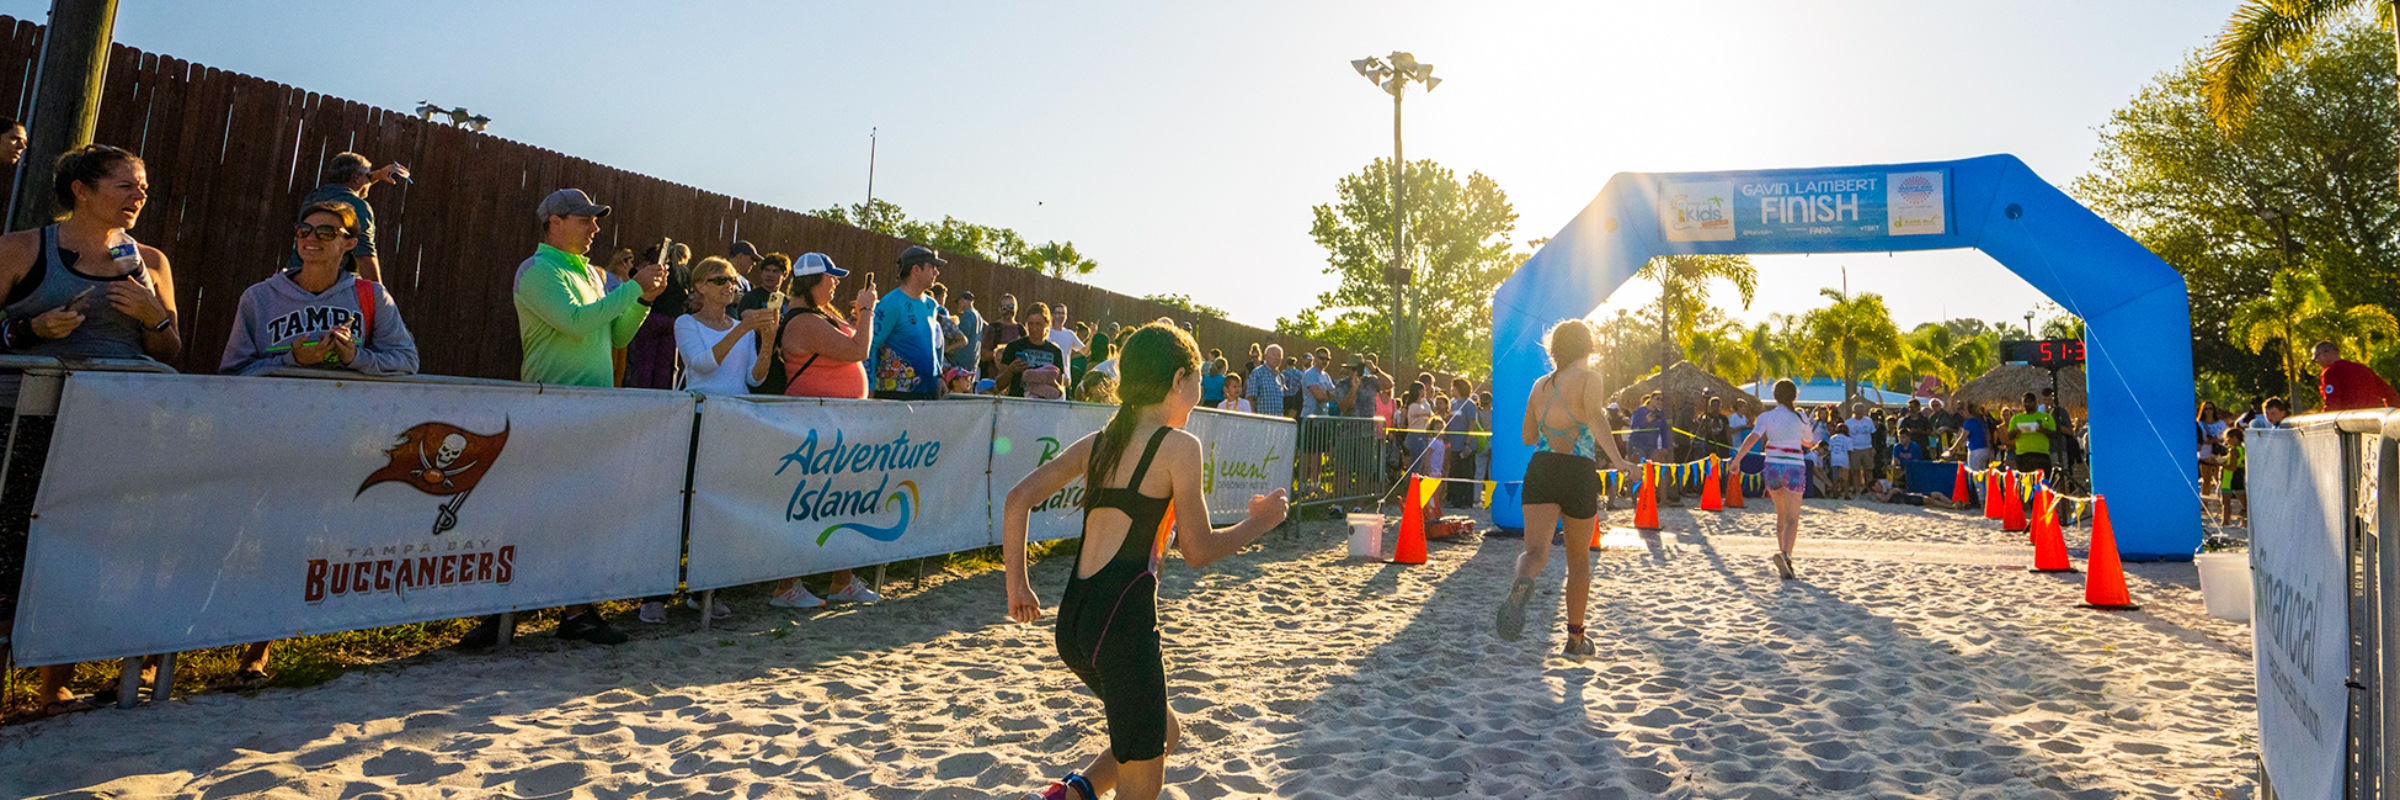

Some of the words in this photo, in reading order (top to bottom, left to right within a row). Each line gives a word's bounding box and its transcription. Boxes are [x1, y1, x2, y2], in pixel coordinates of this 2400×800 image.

[1742, 183, 1790, 196] GAVIN
[1795, 178, 1877, 194] LAMBERT
[1761, 193, 1859, 225] FINISH
[267, 305, 364, 345] TAMPA
[774, 427, 941, 476] Adventure
[1220, 445, 1280, 480] event
[786, 473, 889, 522] Island
[345, 543, 431, 558] TAMPA
[446, 538, 490, 551] BAY
[303, 545, 517, 605] BUCCANEERS
